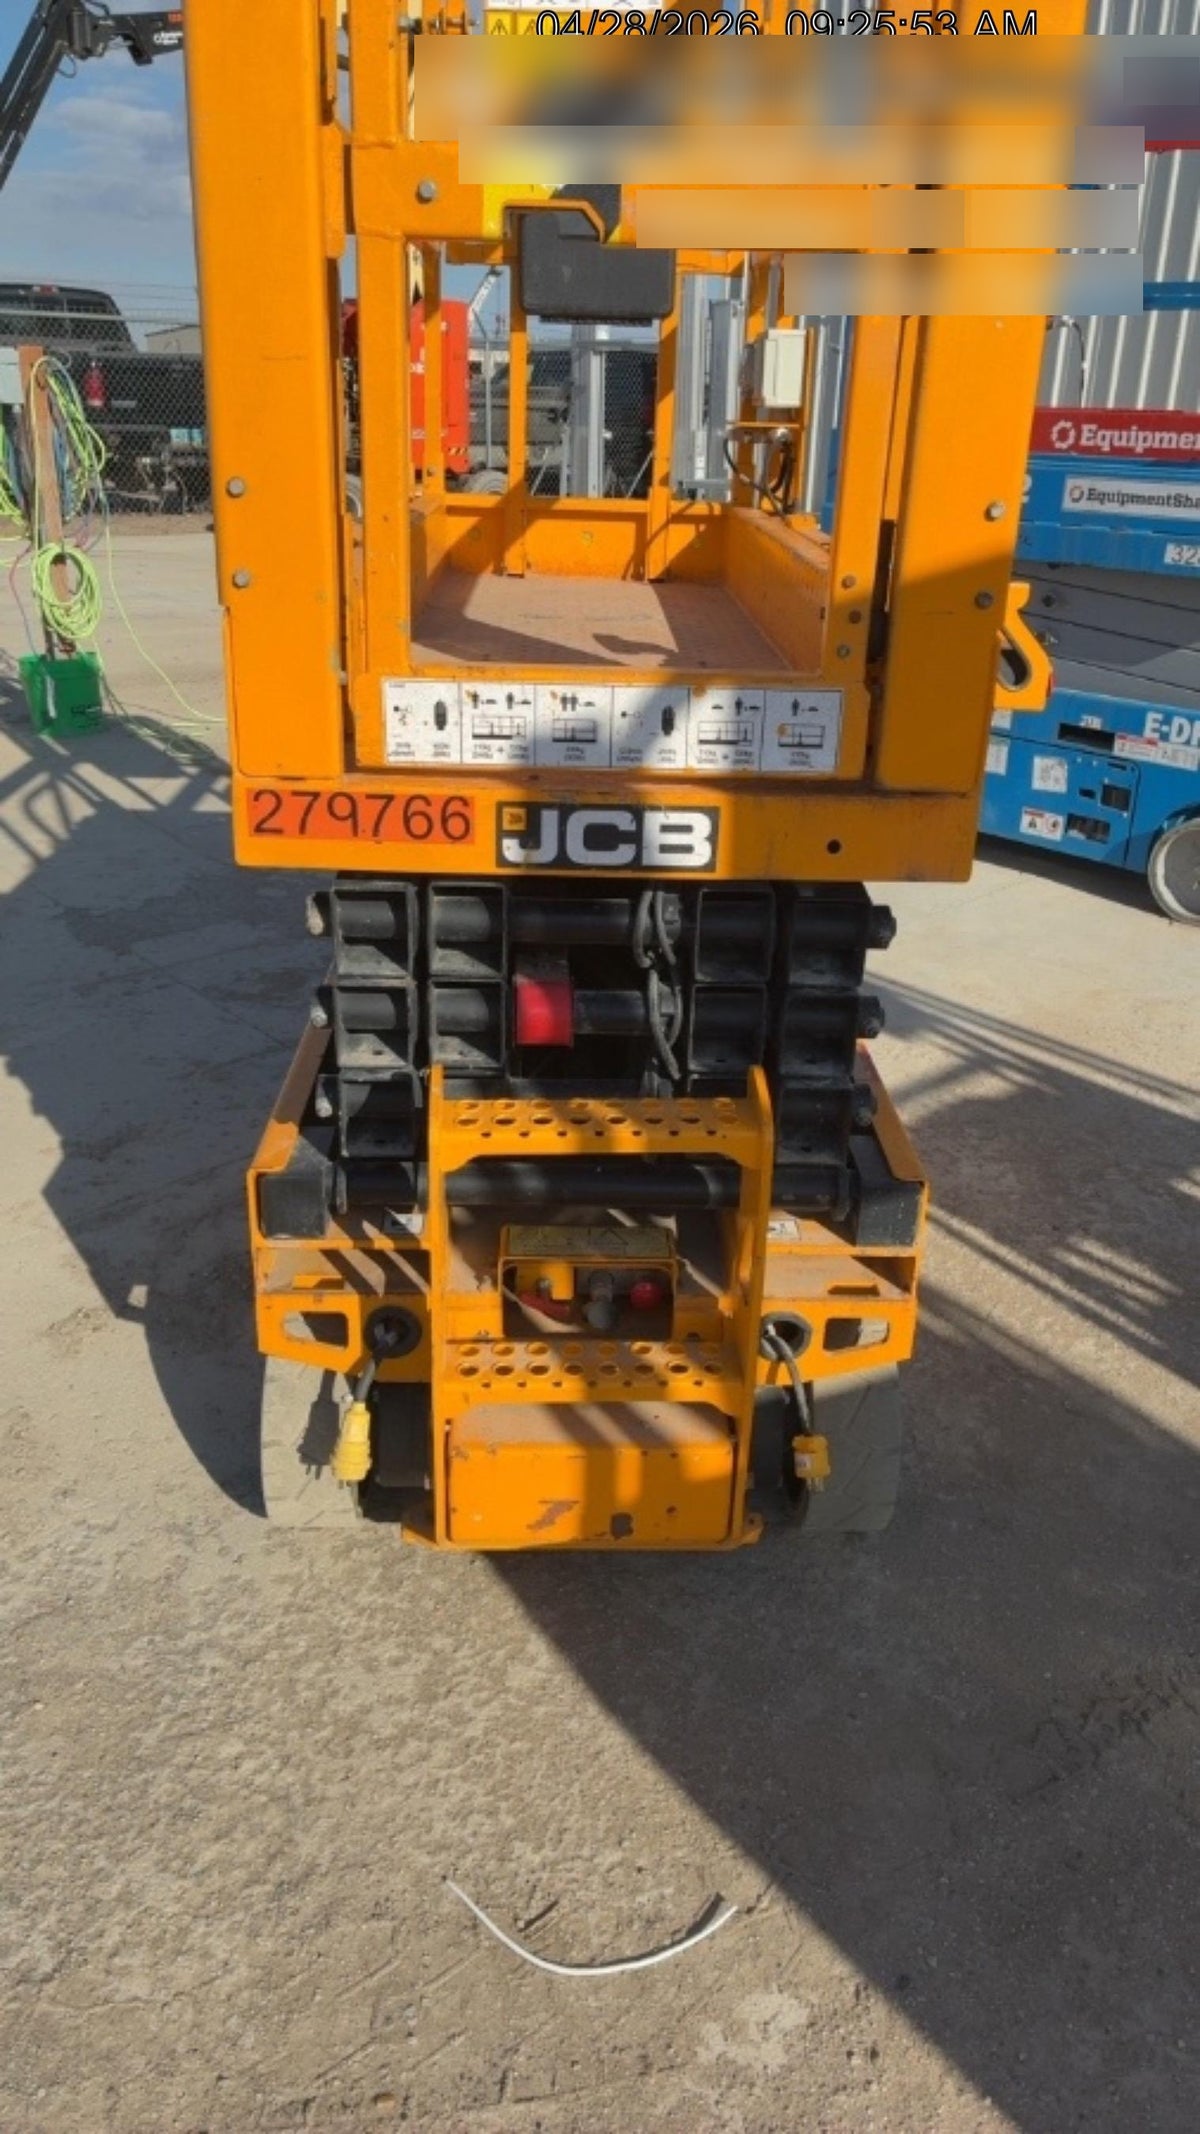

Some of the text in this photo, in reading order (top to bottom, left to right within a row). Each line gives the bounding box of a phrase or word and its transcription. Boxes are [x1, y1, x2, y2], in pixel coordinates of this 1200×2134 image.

[1170, 545, 1200, 567] 32
[252, 788, 472, 842] 279766
[501, 807, 713, 867] JCB
